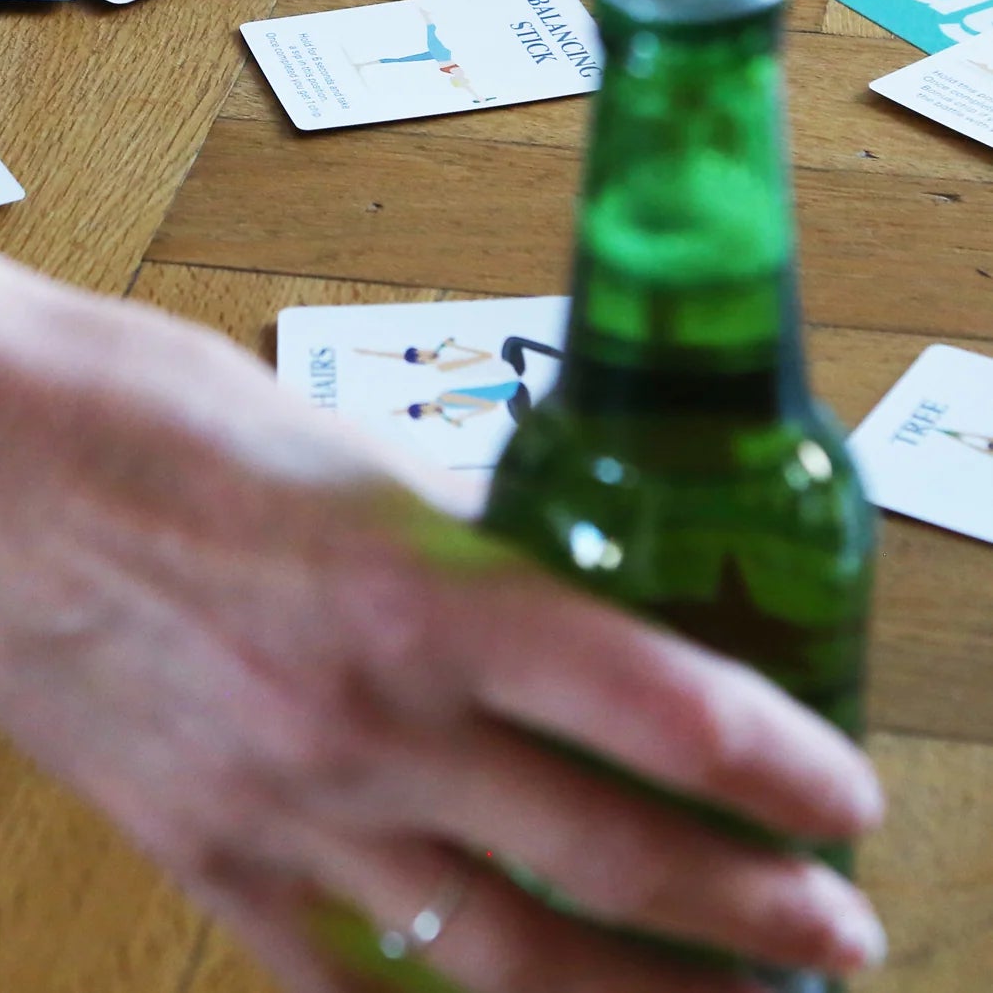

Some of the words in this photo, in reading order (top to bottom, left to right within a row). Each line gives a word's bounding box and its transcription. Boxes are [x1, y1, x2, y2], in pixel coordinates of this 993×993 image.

[266, 32, 280, 47] Once
[510, 21, 558, 65] STICK
[309, 347, 336, 413] HAIRS
[892, 399, 949, 446] TREE
